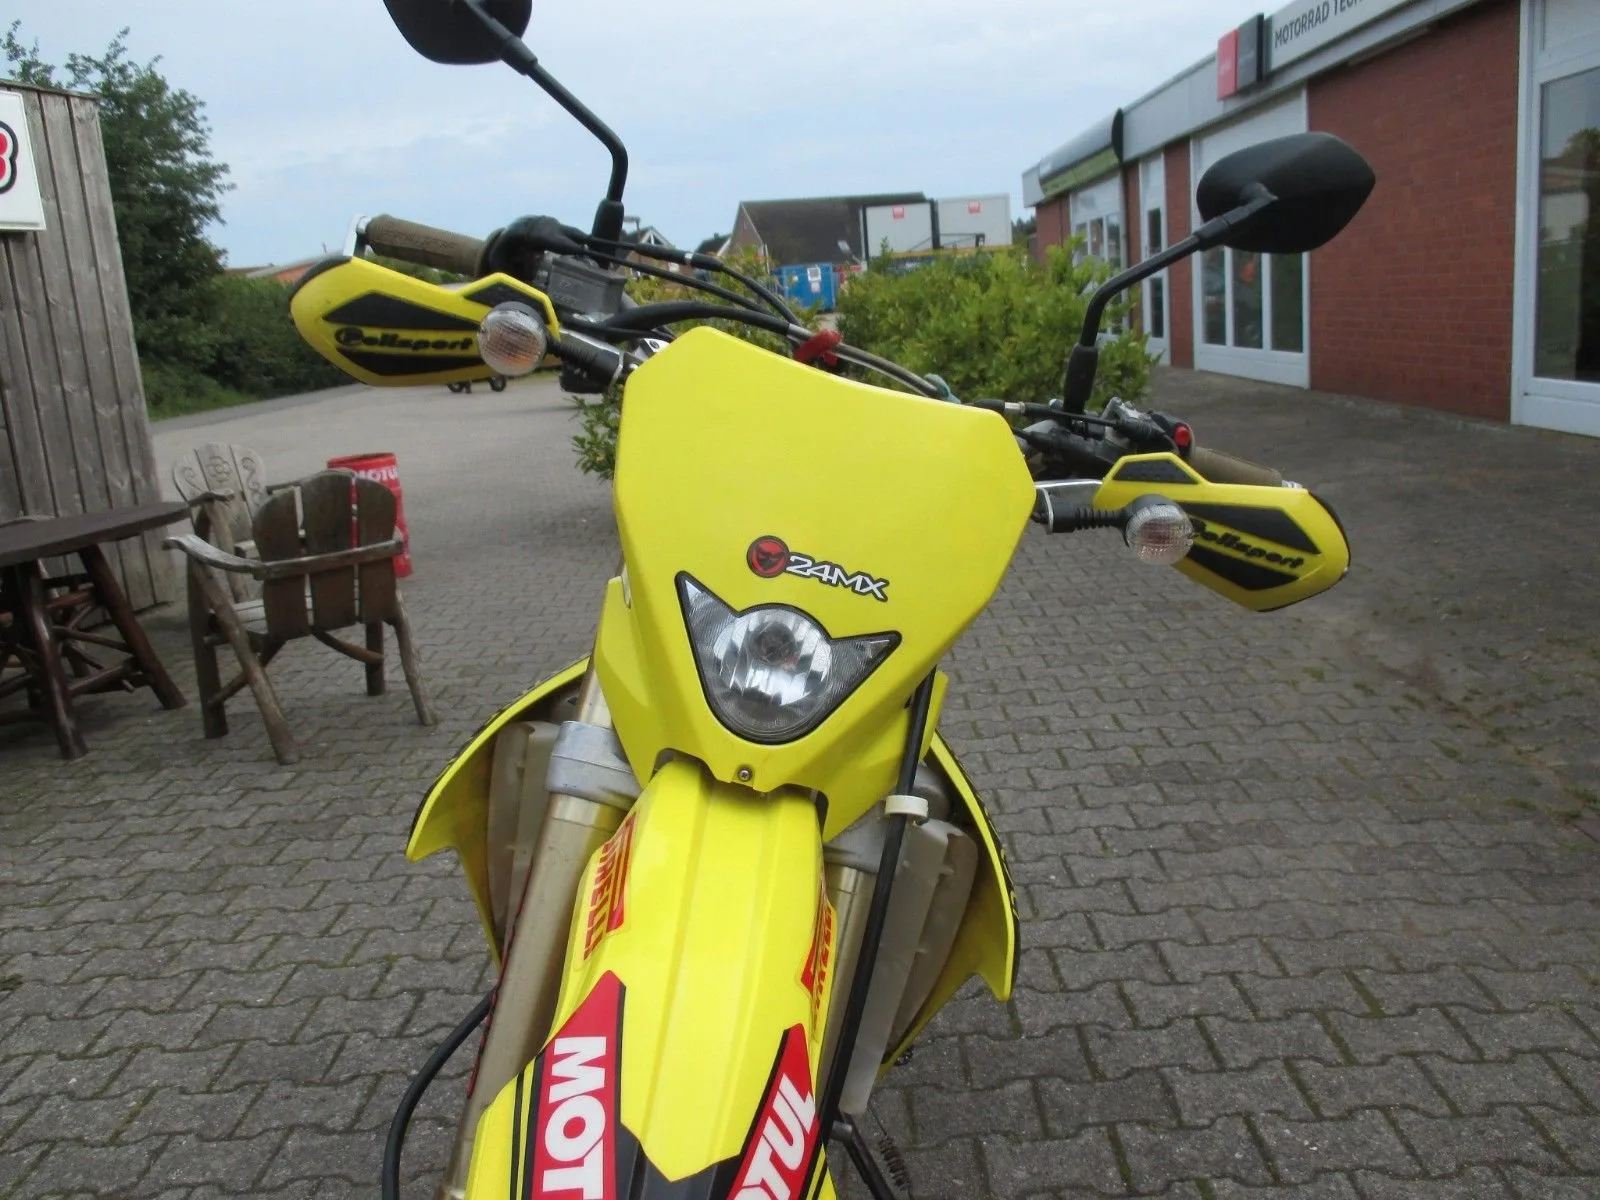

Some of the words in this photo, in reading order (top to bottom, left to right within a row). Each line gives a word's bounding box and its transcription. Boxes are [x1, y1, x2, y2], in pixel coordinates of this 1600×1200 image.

[1274, 1, 1330, 48] MOTORRAD
[1331, 0, 1362, 16] TE
[785, 553, 888, 601] 24MX
[543, 1036, 607, 1200] MOT
[733, 1073, 816, 1200] TUL
